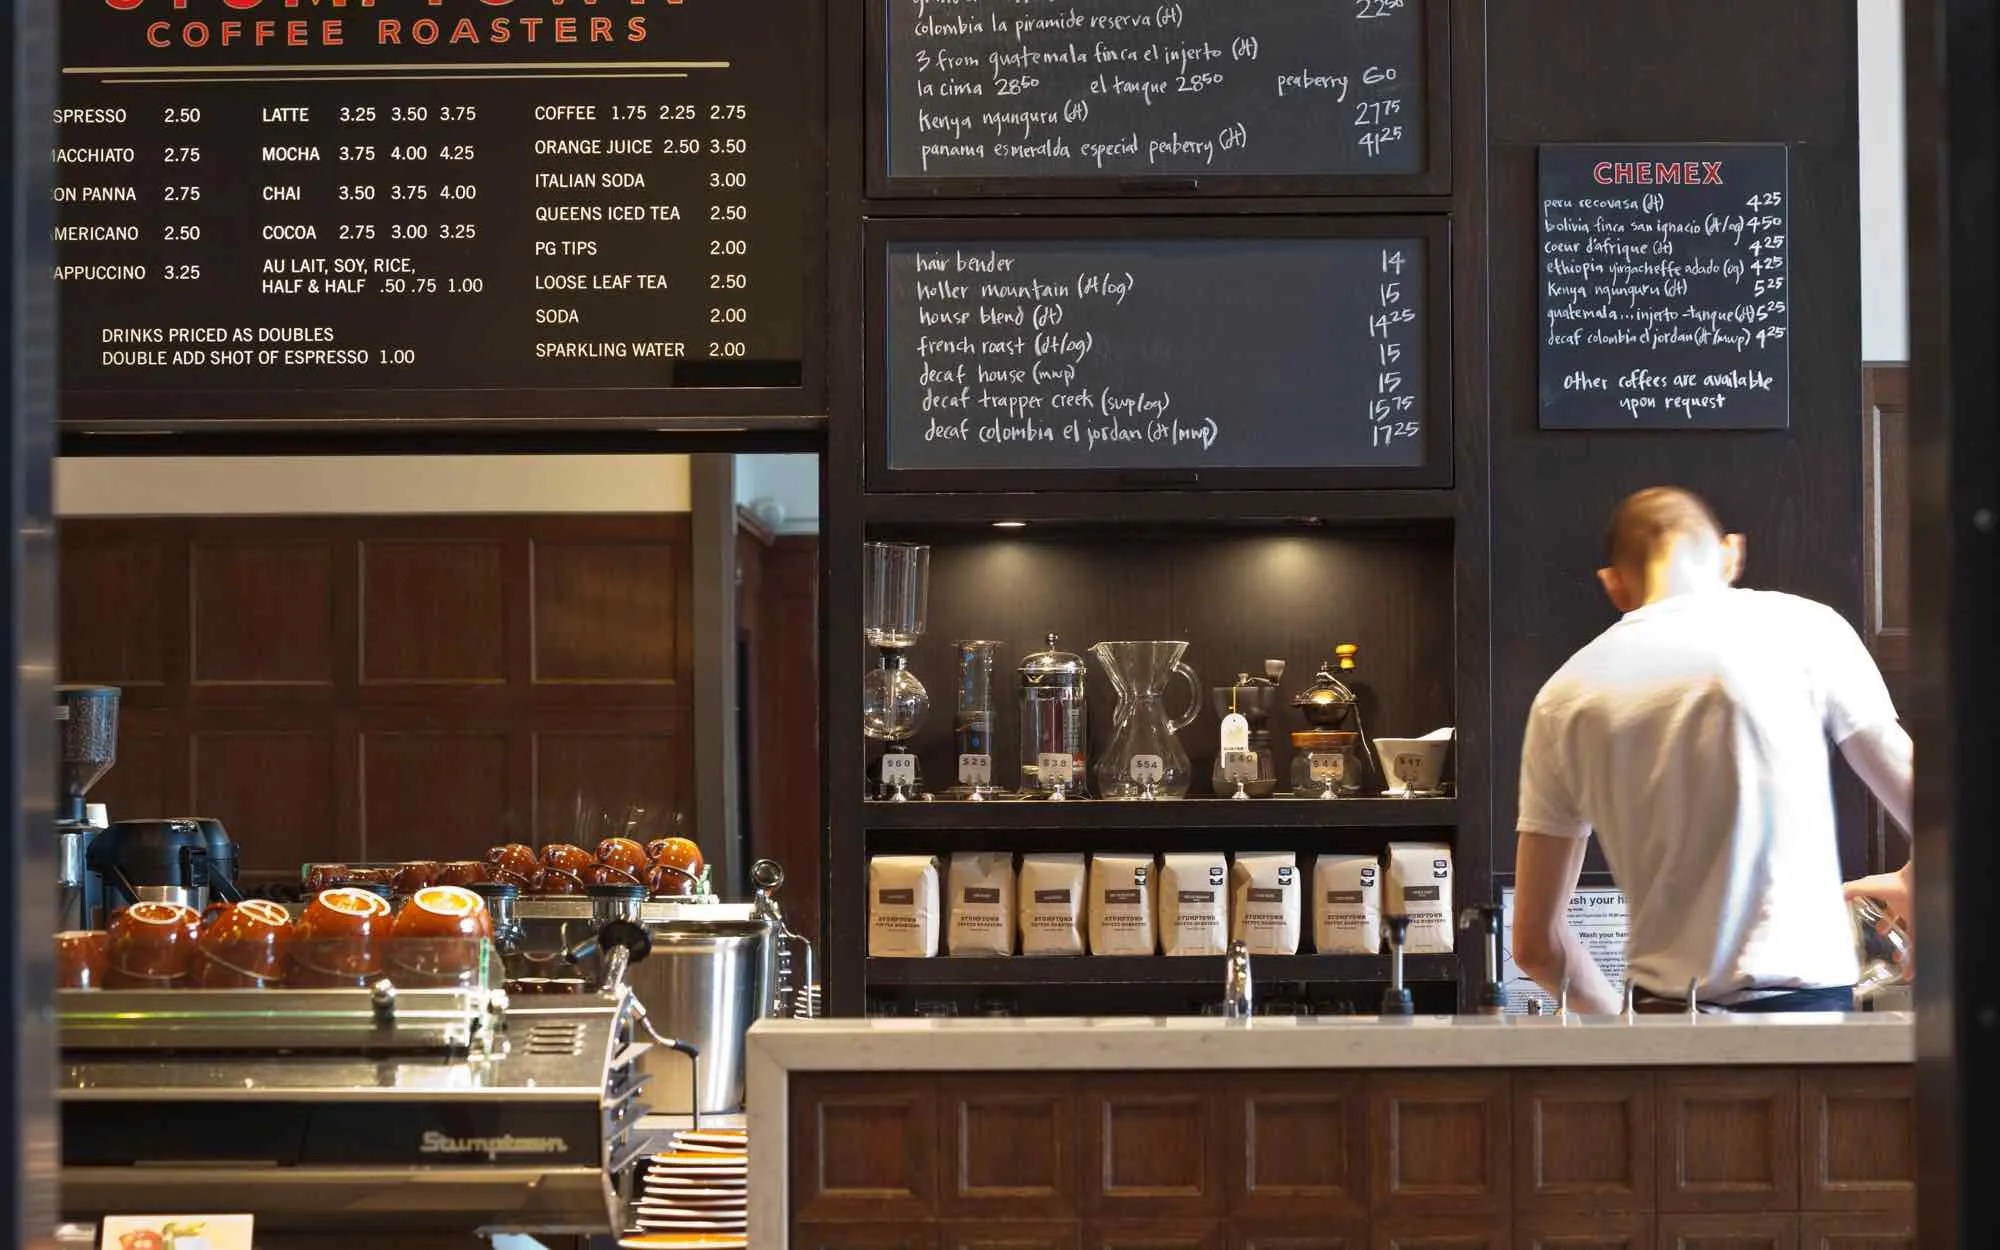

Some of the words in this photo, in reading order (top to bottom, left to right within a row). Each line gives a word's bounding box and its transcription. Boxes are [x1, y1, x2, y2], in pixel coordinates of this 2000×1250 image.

[915, 15, 983, 36] colombia
[992, 12, 1008, 32] la
[1016, 8, 1084, 40] piramide
[1090, 16, 1150, 33] reserva
[147, 20, 344, 47] COFFEE
[378, 17, 647, 45] ROASTERS
[916, 50, 930, 72] 3
[936, 49, 978, 71] from
[990, 44, 1087, 79] guatemala
[1095, 41, 1137, 62] finca
[1144, 44, 1158, 60] el
[1165, 41, 1222, 73] injerto
[918, 80, 933, 97] la
[941, 80, 982, 96] cima
[1090, 75, 1106, 93] el
[1114, 80, 1168, 105] tanque
[1278, 68, 1348, 103] peaberry
[1362, 67, 1396, 84] 60
[53, 109, 126, 123] SPRESSO
[165, 108, 200, 122] 2.50
[263, 108, 309, 122] LATTE
[340, 107, 376, 121] 3.25
[392, 107, 427, 121] 3.50
[440, 107, 476, 120] 3.75
[535, 106, 596, 120] COFFEE
[612, 106, 646, 120] 1.75
[660, 105, 695, 119] 2.25
[711, 105, 746, 119] 2.75
[983, 112, 1057, 139] ngunguru
[263, 147, 320, 161] MOCHA
[339, 146, 375, 160] 3.75
[391, 146, 427, 160] 4.00
[440, 146, 474, 160] 4.25
[535, 140, 601, 154] ORANGE
[606, 140, 652, 154] JUICE
[664, 139, 699, 153] 2.50
[710, 139, 746, 153] 3.50
[922, 144, 984, 171] panama
[994, 136, 1070, 157] esmeralda
[1081, 133, 1138, 168] especial
[1150, 132, 1212, 164] peaberry
[165, 148, 200, 162] 2.75
[536, 173, 595, 188] ITALIAN
[602, 173, 645, 187] SODA
[710, 173, 746, 187] 3.00
[1593, 162, 1724, 184] CHEMEX
[51, 187, 76, 202] ON
[83, 187, 136, 201] PANNA
[165, 187, 200, 200] 2.75
[263, 186, 300, 200] CHAI
[339, 186, 375, 200] 3.50
[392, 185, 427, 200] 3.75
[440, 185, 476, 199] 4.00
[536, 207, 602, 221] QUEENS
[609, 206, 645, 221] ICED
[650, 206, 680, 220] TEA
[711, 206, 746, 220] 2.50
[1544, 200, 1572, 217] peru
[164, 226, 200, 240] 2.50
[263, 225, 316, 239] COCOA
[340, 225, 375, 239] 2.75
[392, 225, 427, 239] 3.00
[440, 225, 475, 238] 3.25
[1544, 217, 1589, 233] bolivia
[1594, 216, 1624, 232] finca
[1631, 224, 1652, 232] san
[1657, 220, 1700, 243] ignacio
[536, 241, 556, 255] PG
[561, 241, 597, 255] TIPS
[710, 240, 746, 255] 2.00
[1544, 241, 1580, 253] coeur
[263, 259, 285, 273] AU
[292, 259, 328, 275] LAIT,
[334, 258, 367, 274] SOY,
[374, 258, 415, 274] RICE,
[917, 253, 949, 272] hair
[957, 251, 1015, 272] bender
[1382, 250, 1406, 274] 14
[1546, 258, 1603, 280] ethiopia
[1685, 258, 1720, 274] adado
[52, 266, 146, 280] APPUCCINO
[164, 265, 200, 279] 3.25
[263, 279, 303, 293] HALF
[308, 279, 319, 293] &
[326, 279, 366, 293] HALF
[381, 279, 405, 293] .50
[412, 279, 436, 293] .75
[449, 278, 483, 292] 1.00
[536, 275, 587, 289] LOOSE
[593, 275, 632, 289] LEAF
[637, 275, 667, 289] TEA
[710, 274, 746, 288] 2.50
[917, 282, 968, 301] holler
[982, 279, 1069, 298] mountain
[1381, 283, 1400, 306] 15
[536, 309, 579, 323] SODA
[710, 308, 746, 323] 2.00
[920, 305, 970, 325] house
[981, 305, 1024, 325] blend
[1034, 304, 1063, 327] (dt)
[103, 329, 163, 342] DRINKS
[169, 328, 227, 342] PRICED
[232, 328, 253, 342] AS
[259, 328, 333, 342] DOUBLES
[1548, 328, 1583, 345] decaf
[1587, 329, 1636, 344] colombia
[1640, 328, 1650, 343] el
[536, 343, 626, 357] SPARKLING
[632, 343, 684, 357] WATER
[709, 342, 745, 356] 2.00
[917, 336, 974, 355] french
[982, 337, 1024, 354] roast
[1035, 331, 1092, 363] (dt/og)
[1380, 344, 1401, 366] 15
[103, 351, 167, 365] DOUBLE
[173, 351, 205, 365] ADD
[211, 351, 253, 365] SHOT
[259, 350, 279, 364] OF
[285, 350, 368, 364] ESPRESSO
[381, 350, 414, 364] 1.00
[920, 364, 967, 385] decaf
[979, 365, 1025, 382] house
[1379, 372, 1401, 393] 15
[1619, 369, 1667, 388] coffees
[1674, 373, 1697, 387] are
[1704, 370, 1773, 390] available
[922, 388, 970, 412] decaf
[978, 391, 1042, 418] trapper
[1052, 389, 1094, 408] creek
[1620, 397, 1656, 418] upon
[1665, 394, 1726, 419] request
[925, 419, 969, 441] decaf
[979, 420, 1054, 442] colombia
[1063, 421, 1079, 442] el
[1087, 419, 1142, 450] jordan
[1590, 898, 1614, 906] your
